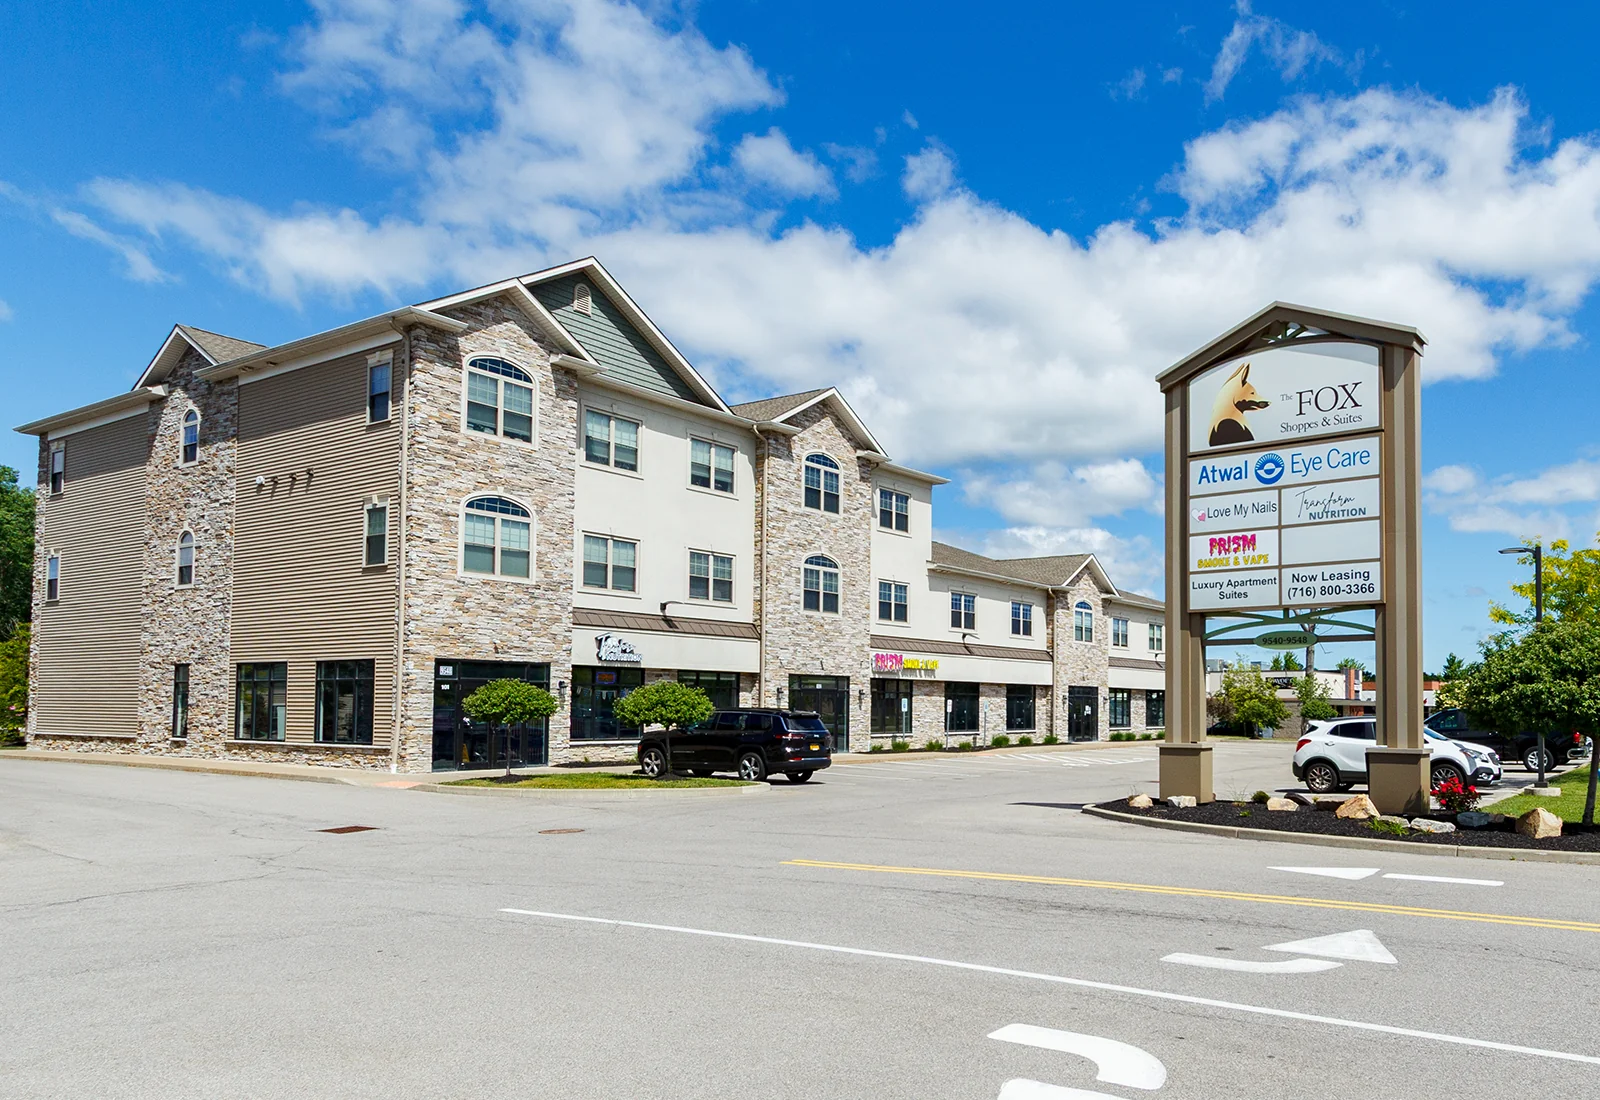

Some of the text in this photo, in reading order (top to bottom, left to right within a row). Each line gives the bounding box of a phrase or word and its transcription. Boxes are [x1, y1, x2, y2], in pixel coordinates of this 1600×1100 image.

[1280, 381, 1362, 416] The FOX
[1280, 413, 1363, 433] Shoppes & Suites
[1198, 448, 1371, 485] Atwal Eye Care
[1207, 501, 1278, 519] Love My Nails
[1295, 486, 1356, 518] Transform
[1309, 507, 1367, 520] NUTRITION
[1209, 534, 1257, 556] PRISM
[1197, 554, 1269, 569] SMOKE & VAPE
[1192, 577, 1277, 591] Luxury Apartment
[1292, 570, 1370, 584] Now Leasing
[1218, 590, 1248, 600] Suites
[1287, 583, 1375, 600] (716) 800-3366
[1262, 636, 1308, 645] 9540-9548
